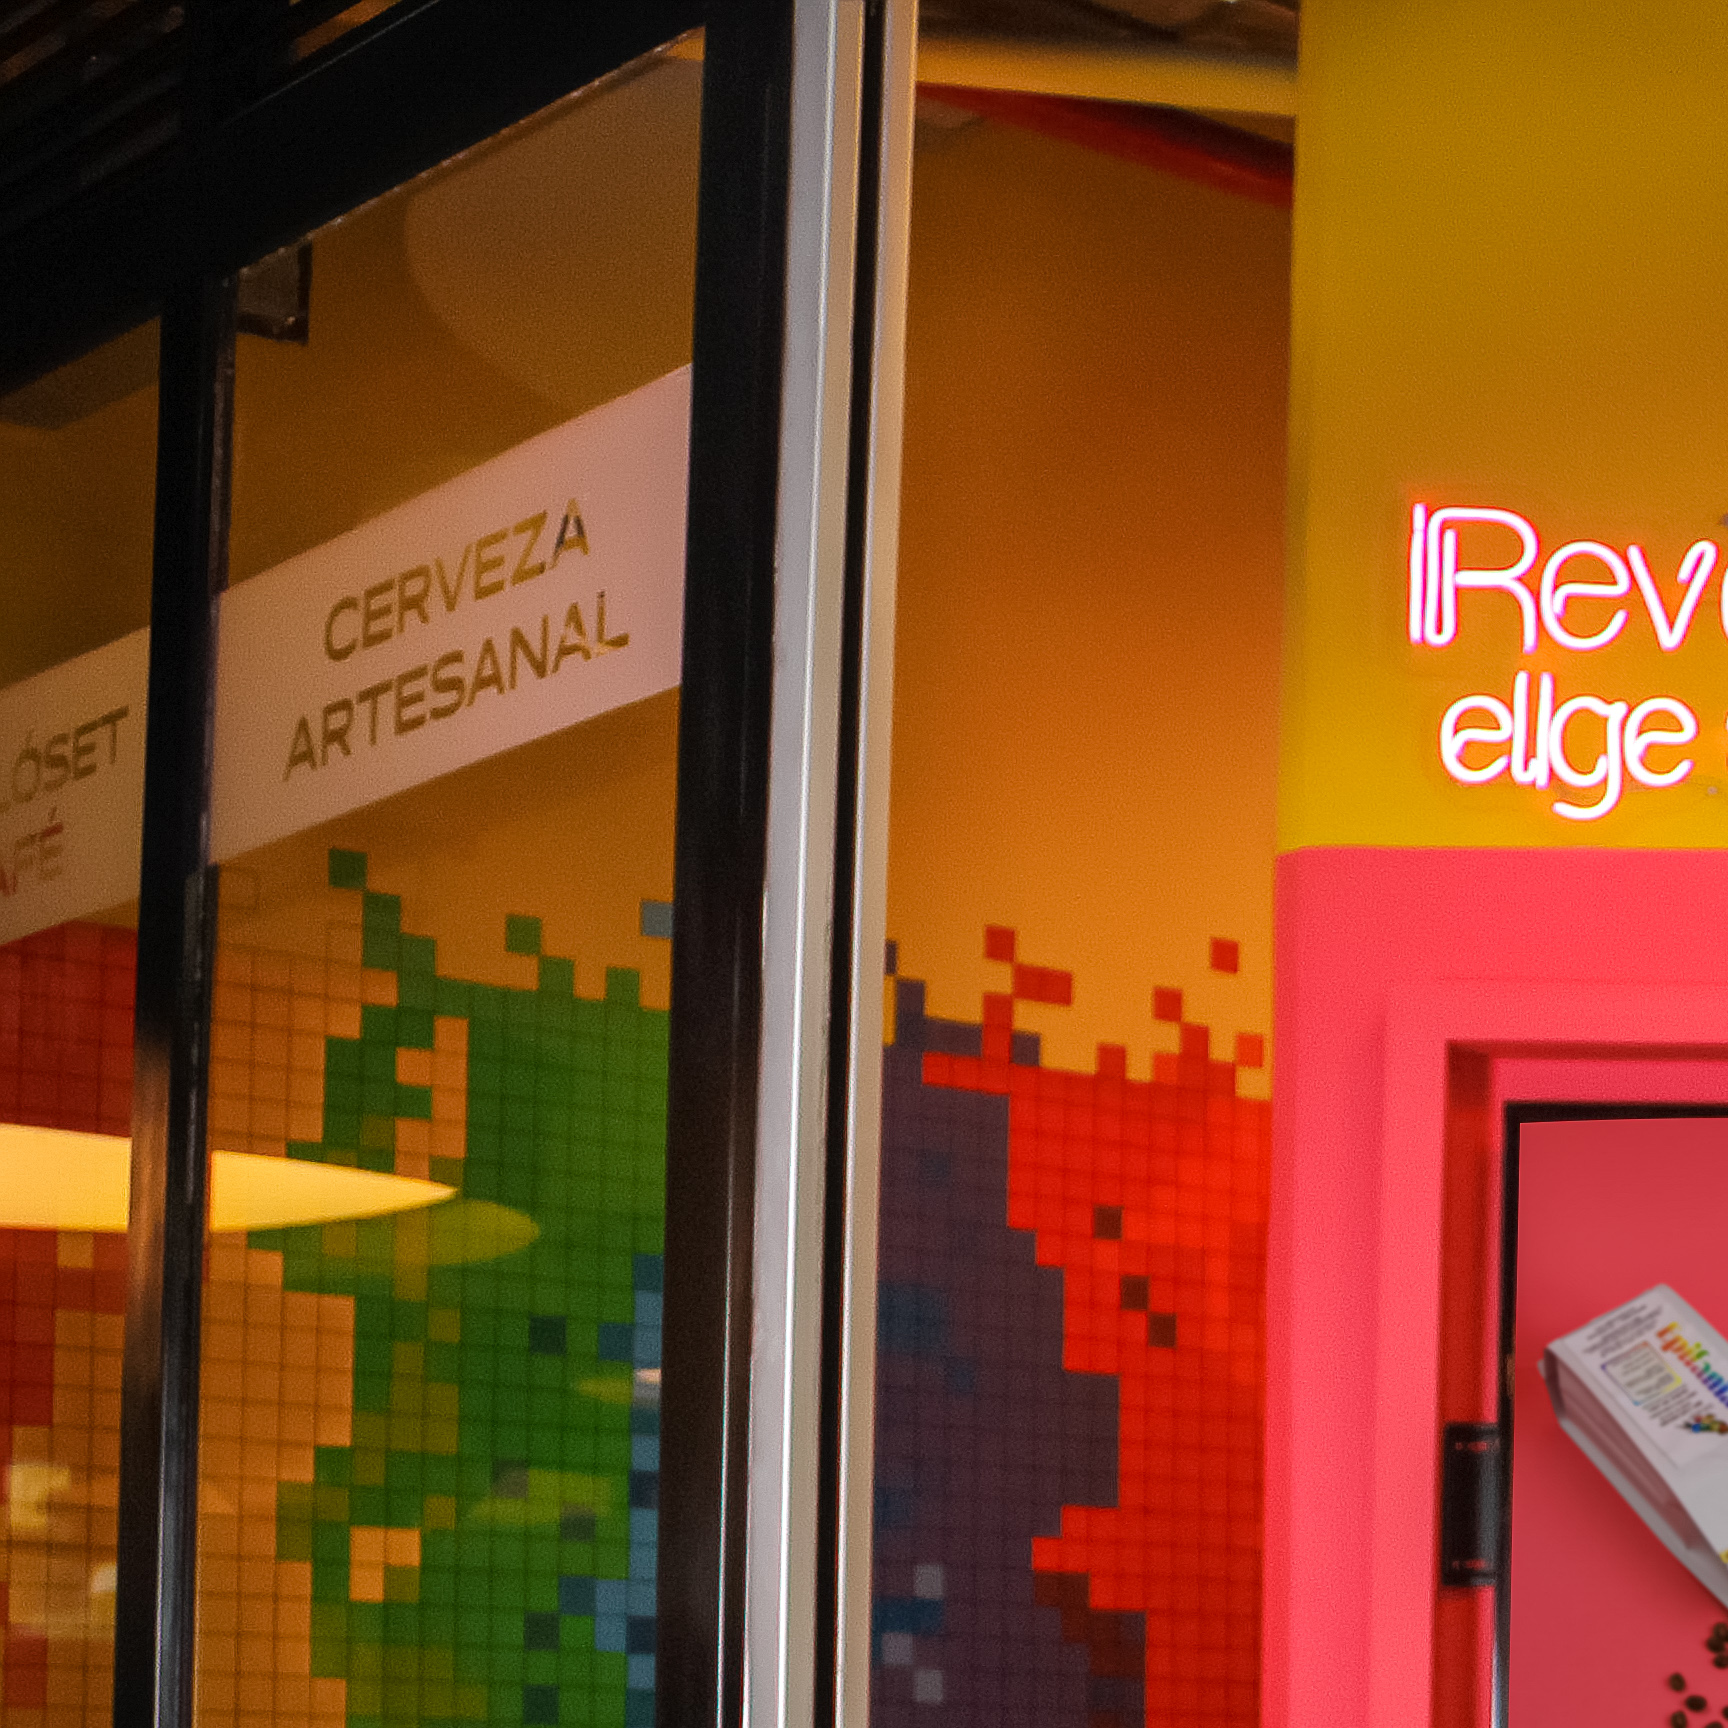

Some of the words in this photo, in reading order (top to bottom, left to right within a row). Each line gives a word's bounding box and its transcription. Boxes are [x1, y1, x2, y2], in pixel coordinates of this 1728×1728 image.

[323, 498, 590, 665] CERVEZA
[0, 704, 130, 813] ÓSET
[283, 591, 630, 783] ARTESANAL
[1440, 670, 1698, 821] elige
